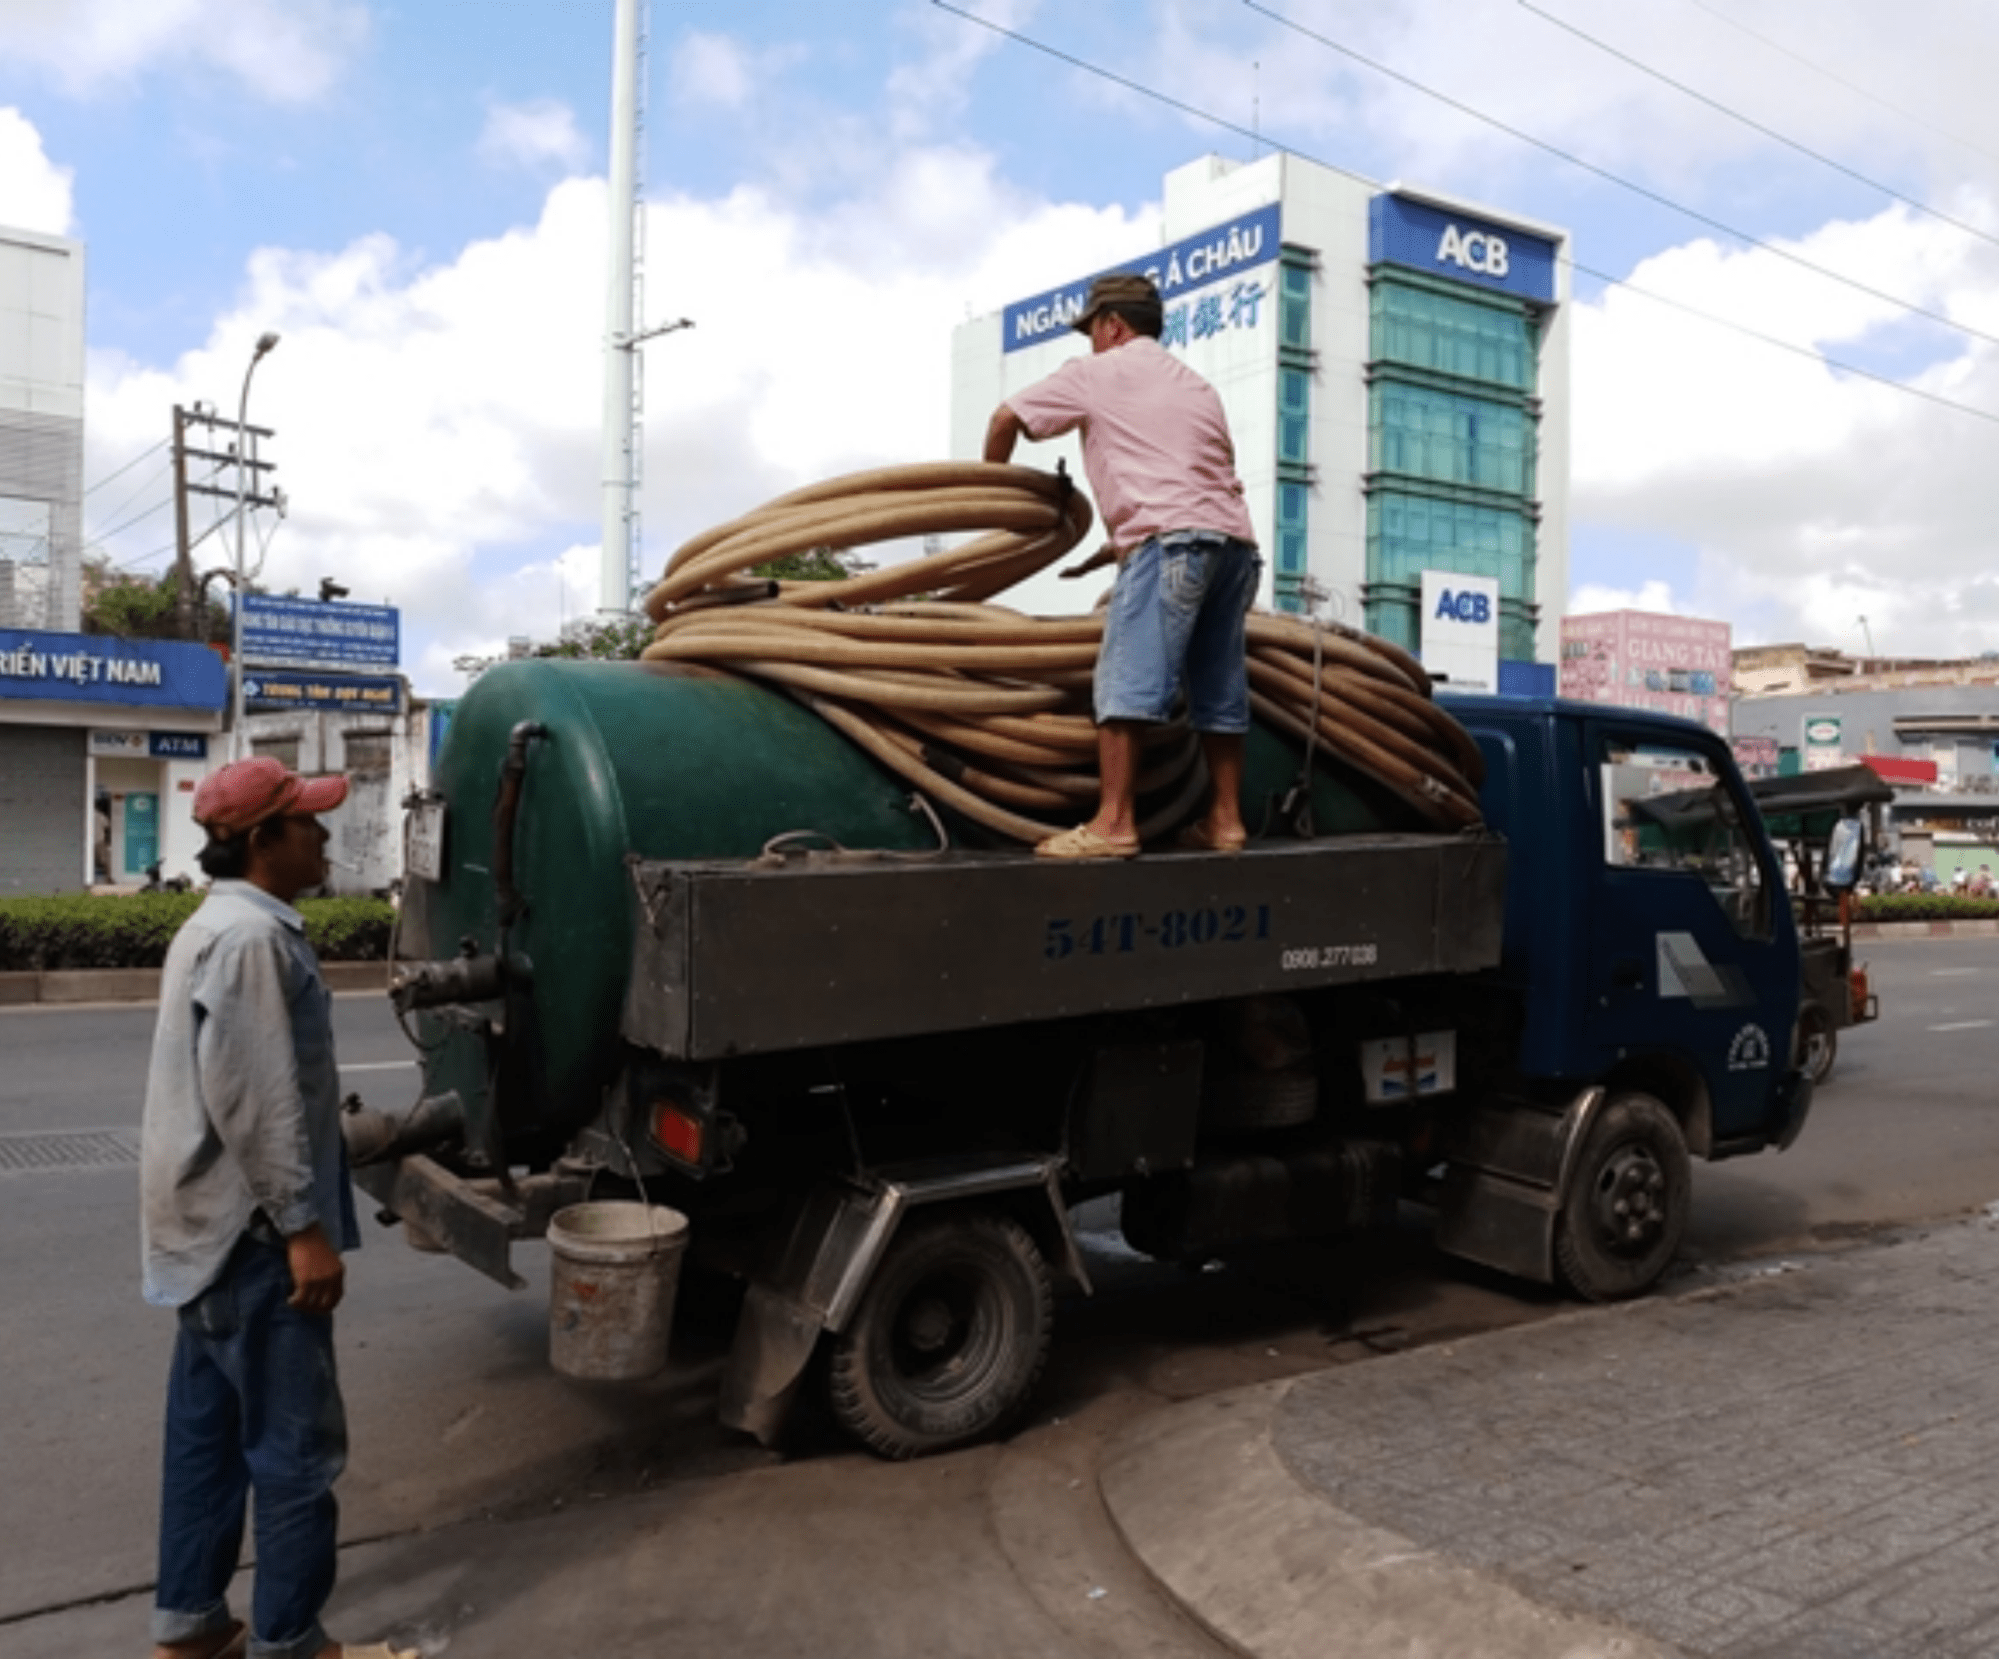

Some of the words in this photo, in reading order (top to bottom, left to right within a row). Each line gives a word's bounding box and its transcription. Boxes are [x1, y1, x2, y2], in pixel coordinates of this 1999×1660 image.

[1436, 224, 1510, 277] ACB
[1015, 294, 1084, 340] NGÂN
[1164, 251, 1183, 290] Á
[1186, 225, 1263, 279] CHÂU
[1434, 588, 1490, 624] ACB
[50, 650, 103, 685] VIỆT
[106, 659, 161, 685] NAM
[158, 735, 200, 752] ATM
[1044, 903, 1271, 960] 54T-8021
